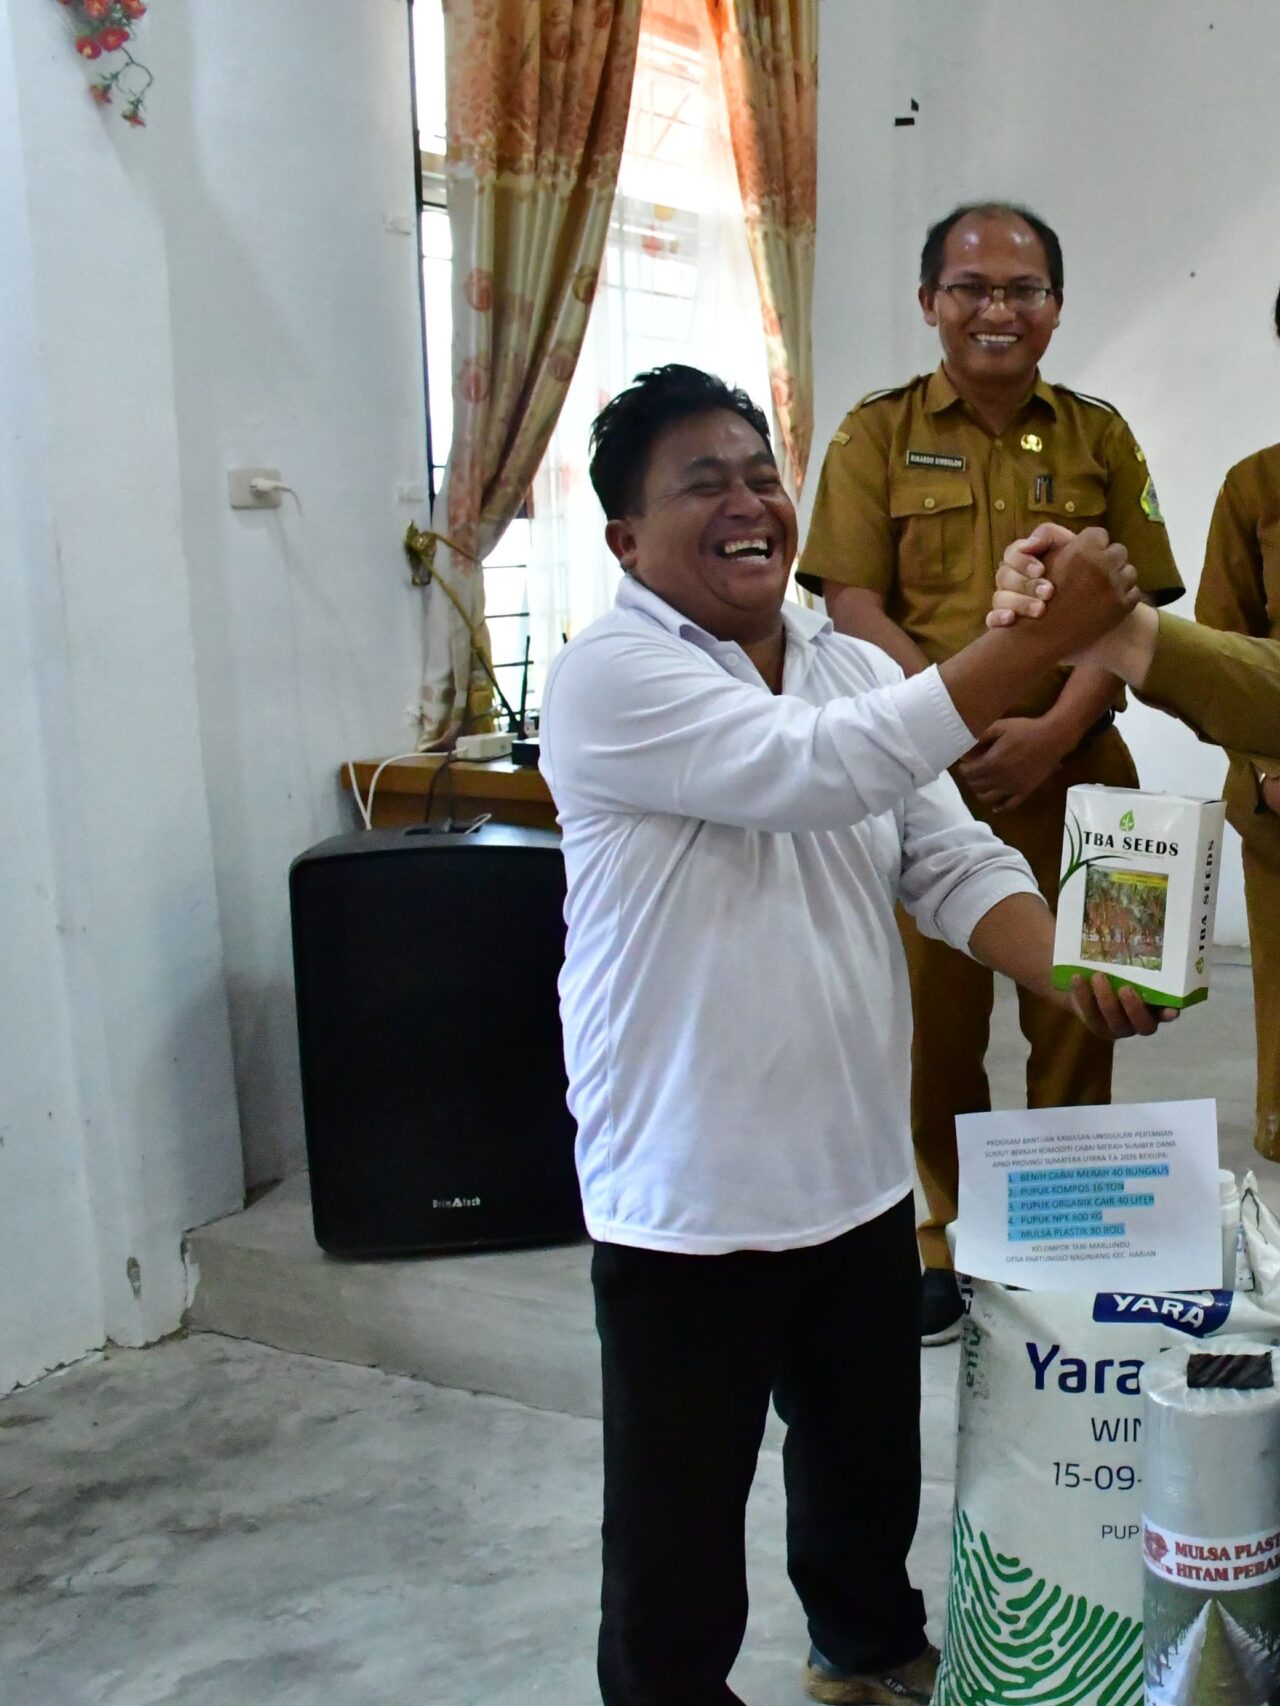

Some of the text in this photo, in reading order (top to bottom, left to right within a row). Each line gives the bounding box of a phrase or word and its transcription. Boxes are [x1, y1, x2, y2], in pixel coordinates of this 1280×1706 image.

[1083, 831, 1115, 848] TBA
[1122, 836, 1179, 857] SEEDS
[1113, 1294, 1205, 1329] YARA
[1025, 1342, 1145, 1396] Yara
[1101, 1524, 1140, 1540] PUP
[1174, 1541, 1232, 1561] MULSA
[1175, 1562, 1230, 1582] HITAM
